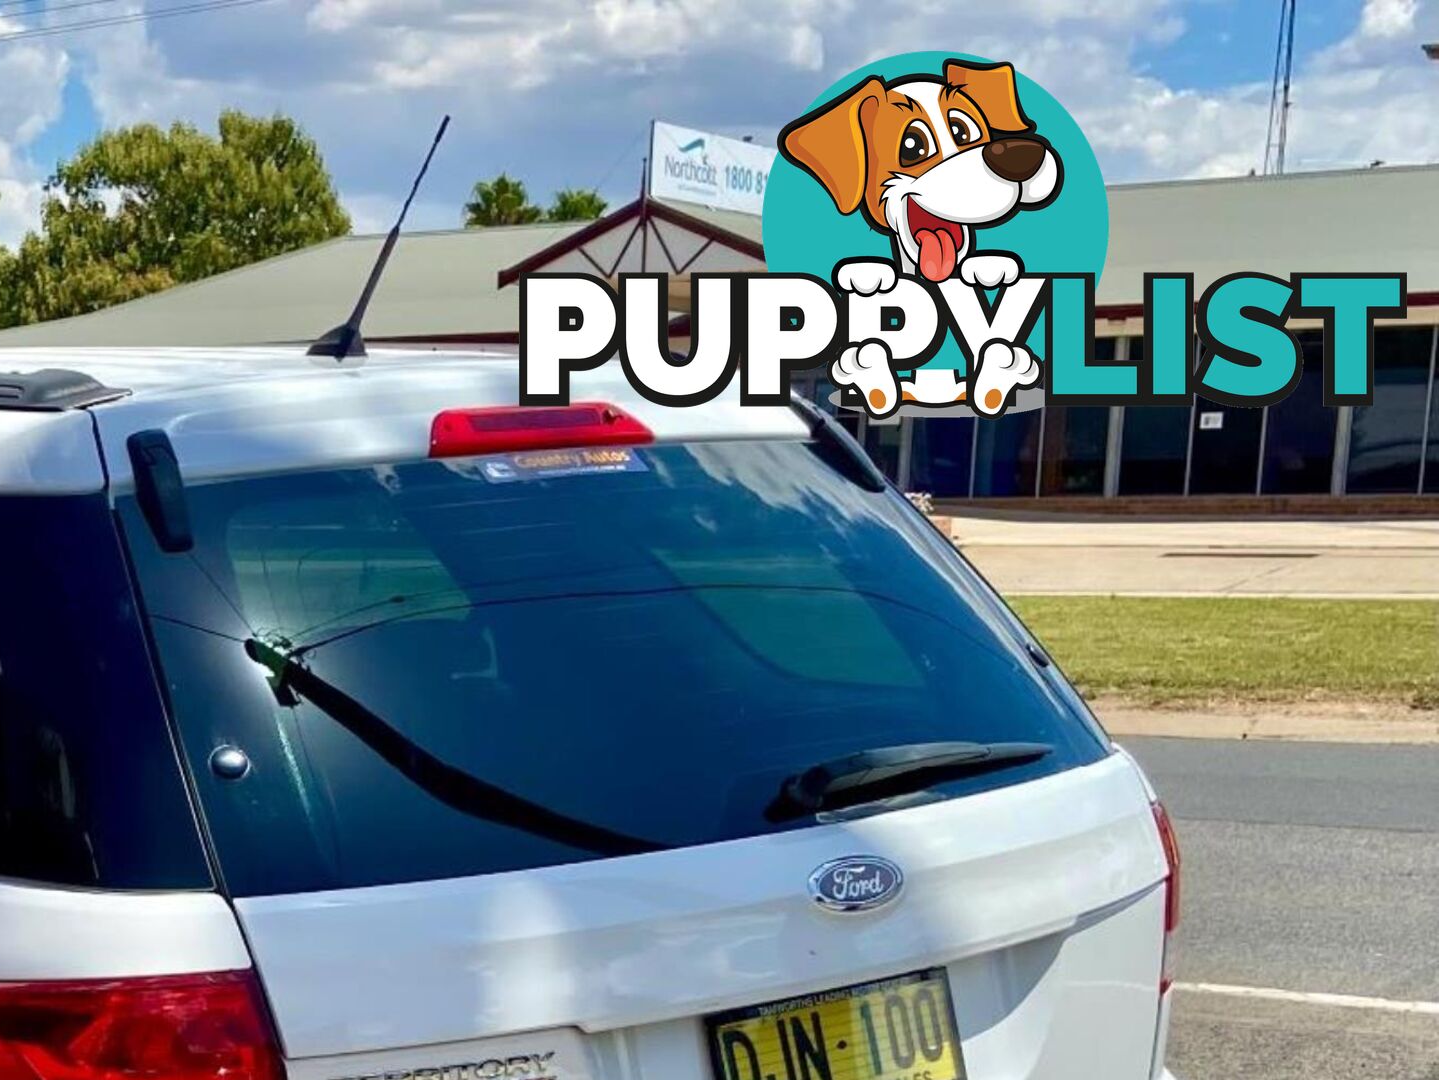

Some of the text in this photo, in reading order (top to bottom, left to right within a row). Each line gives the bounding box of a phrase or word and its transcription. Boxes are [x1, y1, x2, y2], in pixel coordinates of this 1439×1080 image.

[664, 156, 717, 187] Northcott
[725, 165, 752, 193] 1800
[832, 865, 884, 900] Ford
[860, 988, 943, 1075] 100
